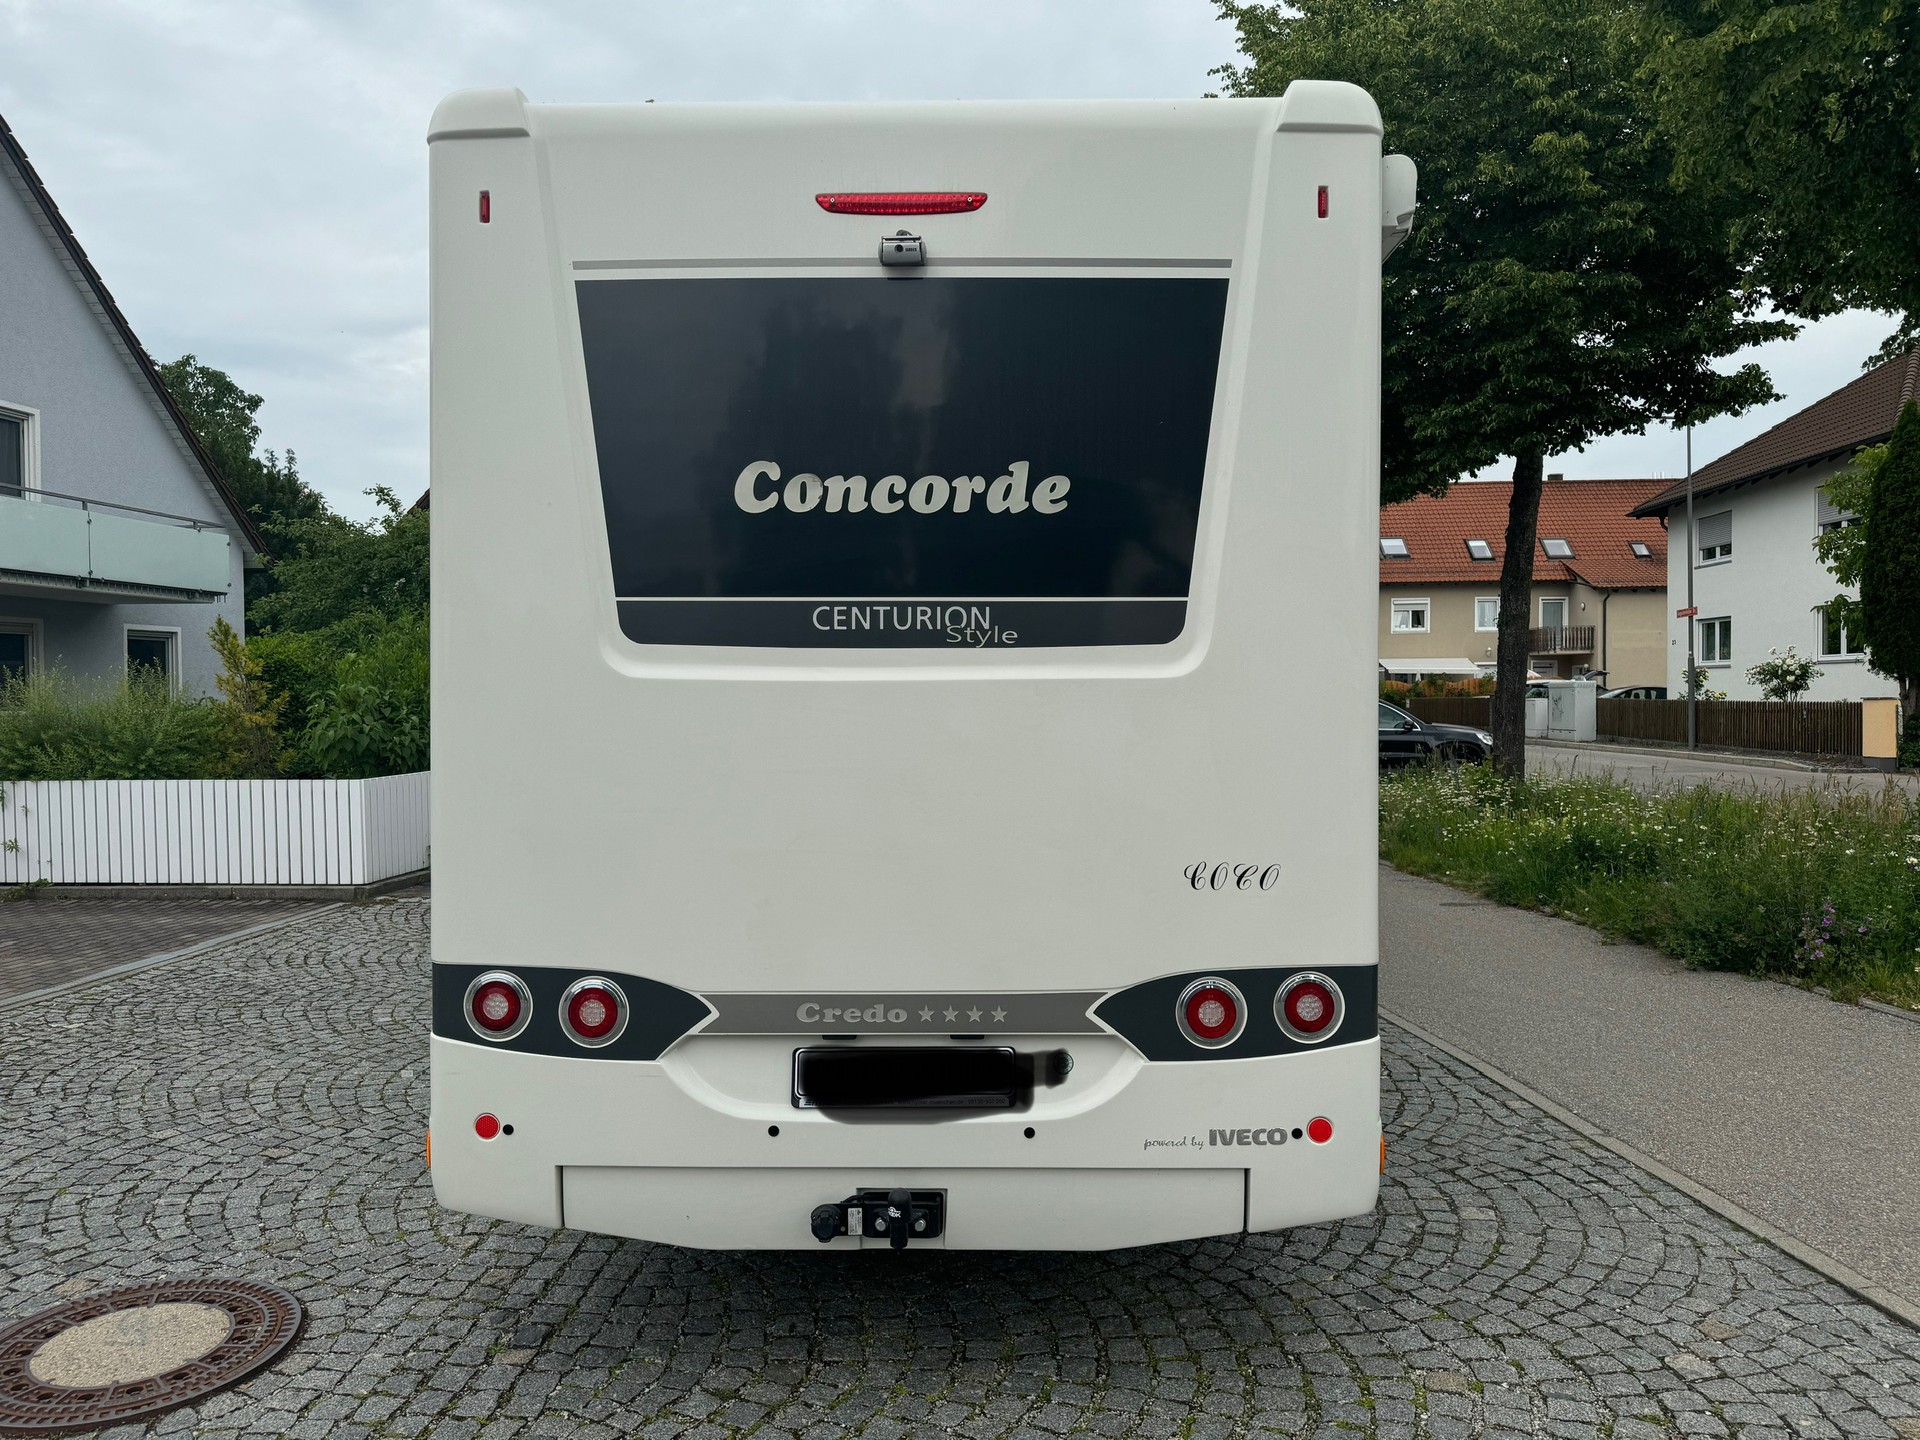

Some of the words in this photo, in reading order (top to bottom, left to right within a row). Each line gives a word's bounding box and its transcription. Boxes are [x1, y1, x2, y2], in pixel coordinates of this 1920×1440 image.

[733, 460, 1071, 514] Concorde
[812, 605, 990, 631] CENTURION
[946, 625, 1018, 648] Style
[796, 1002, 908, 1023] Credo
[1143, 1135, 1187, 1151] powered
[1190, 1136, 1204, 1150] by
[1208, 1127, 1288, 1147] IVECO
